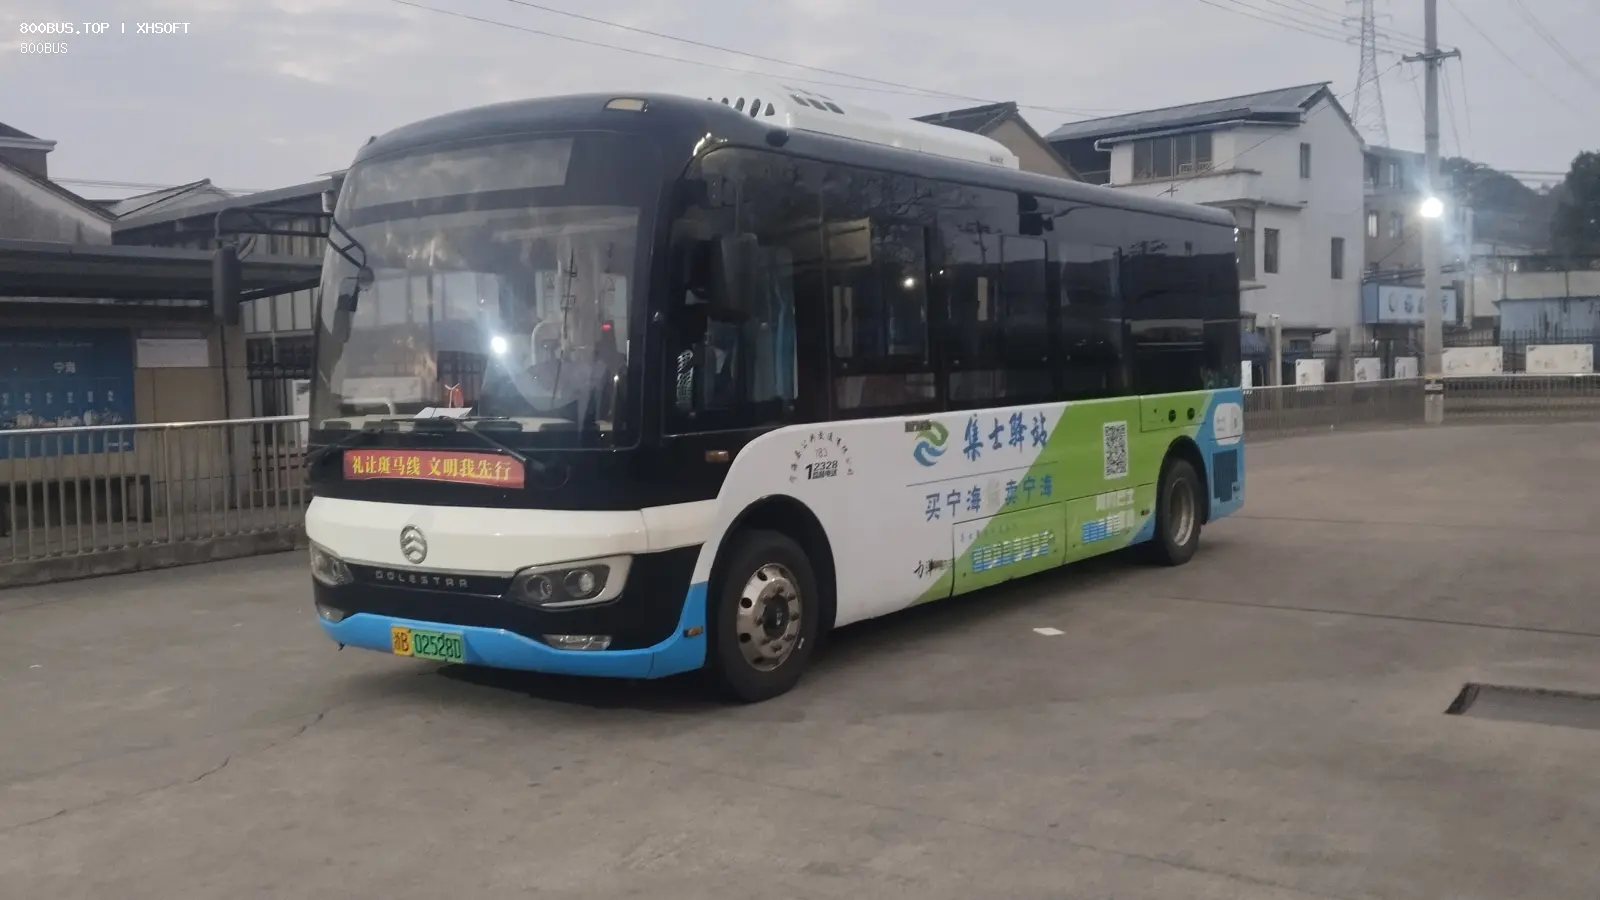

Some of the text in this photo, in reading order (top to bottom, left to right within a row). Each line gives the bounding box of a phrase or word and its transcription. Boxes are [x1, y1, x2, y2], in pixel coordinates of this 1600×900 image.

[351, 455, 512, 481] 礼让斑马线 文明我先行
[805, 460, 838, 480] 12328
[925, 484, 982, 522] 买宁海
[1004, 473, 1053, 505] 卖宁海
